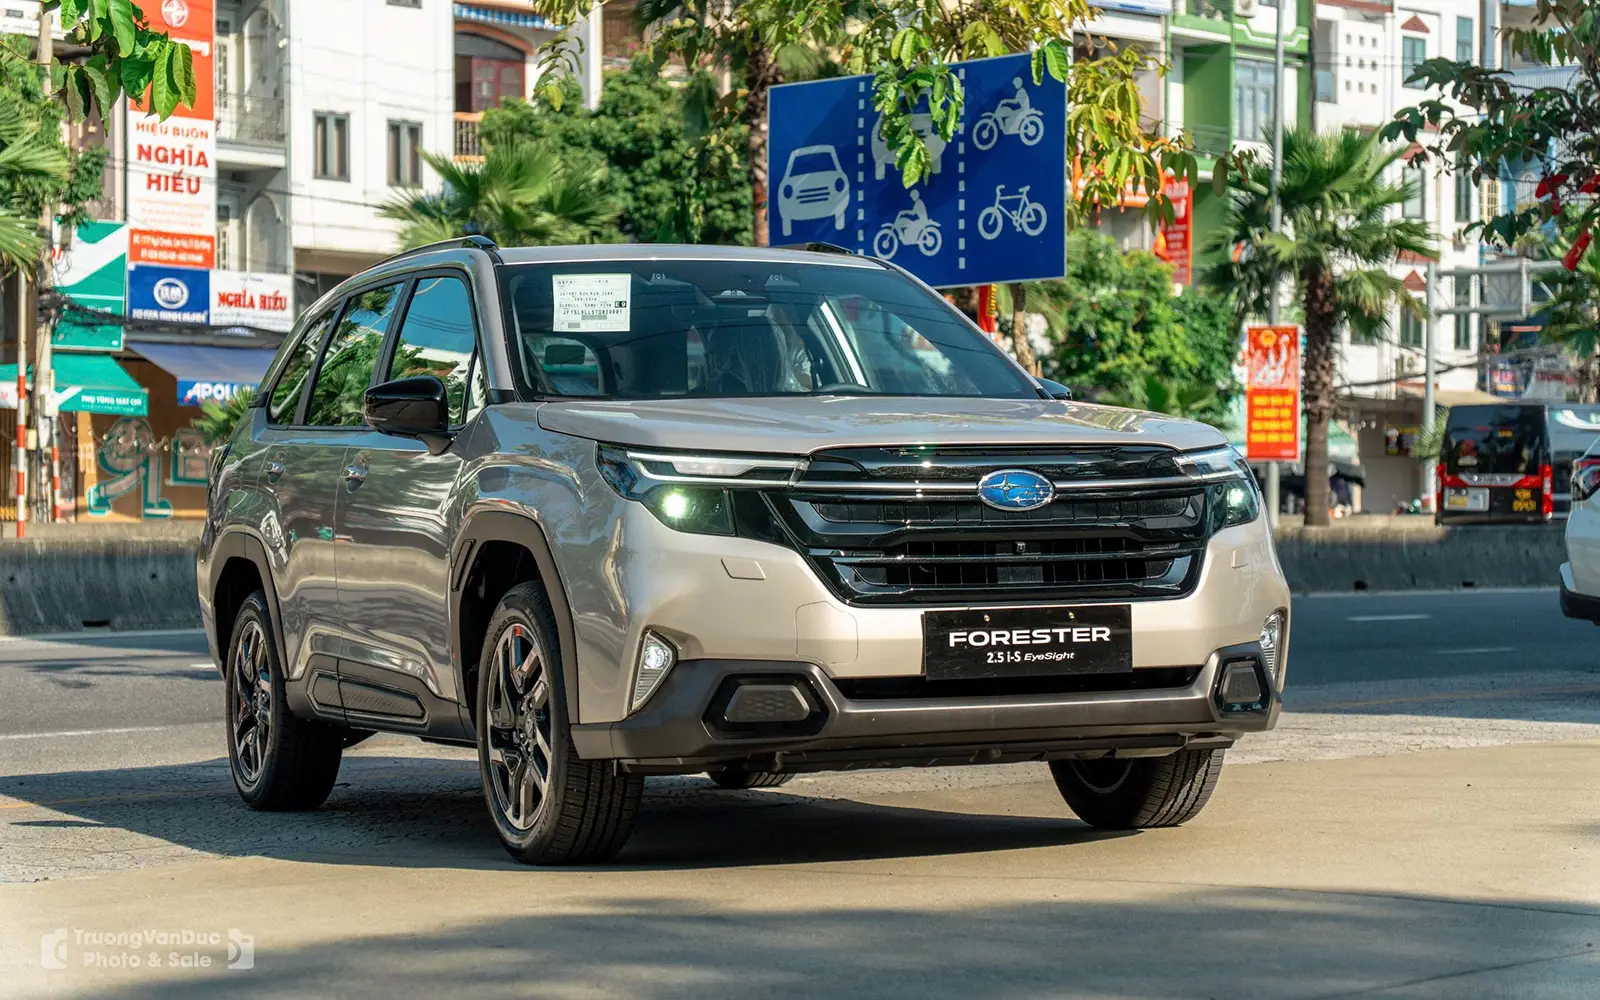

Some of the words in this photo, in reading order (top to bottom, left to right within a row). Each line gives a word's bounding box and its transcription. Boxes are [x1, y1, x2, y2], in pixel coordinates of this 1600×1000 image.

[136, 143, 209, 168] NGHĨA
[146, 168, 201, 194] HIẾU
[949, 627, 1111, 647] FORESTER
[986, 652, 1004, 664] 2.5
[1007, 650, 1021, 663] i-S
[1023, 651, 1076, 662] EyeSight
